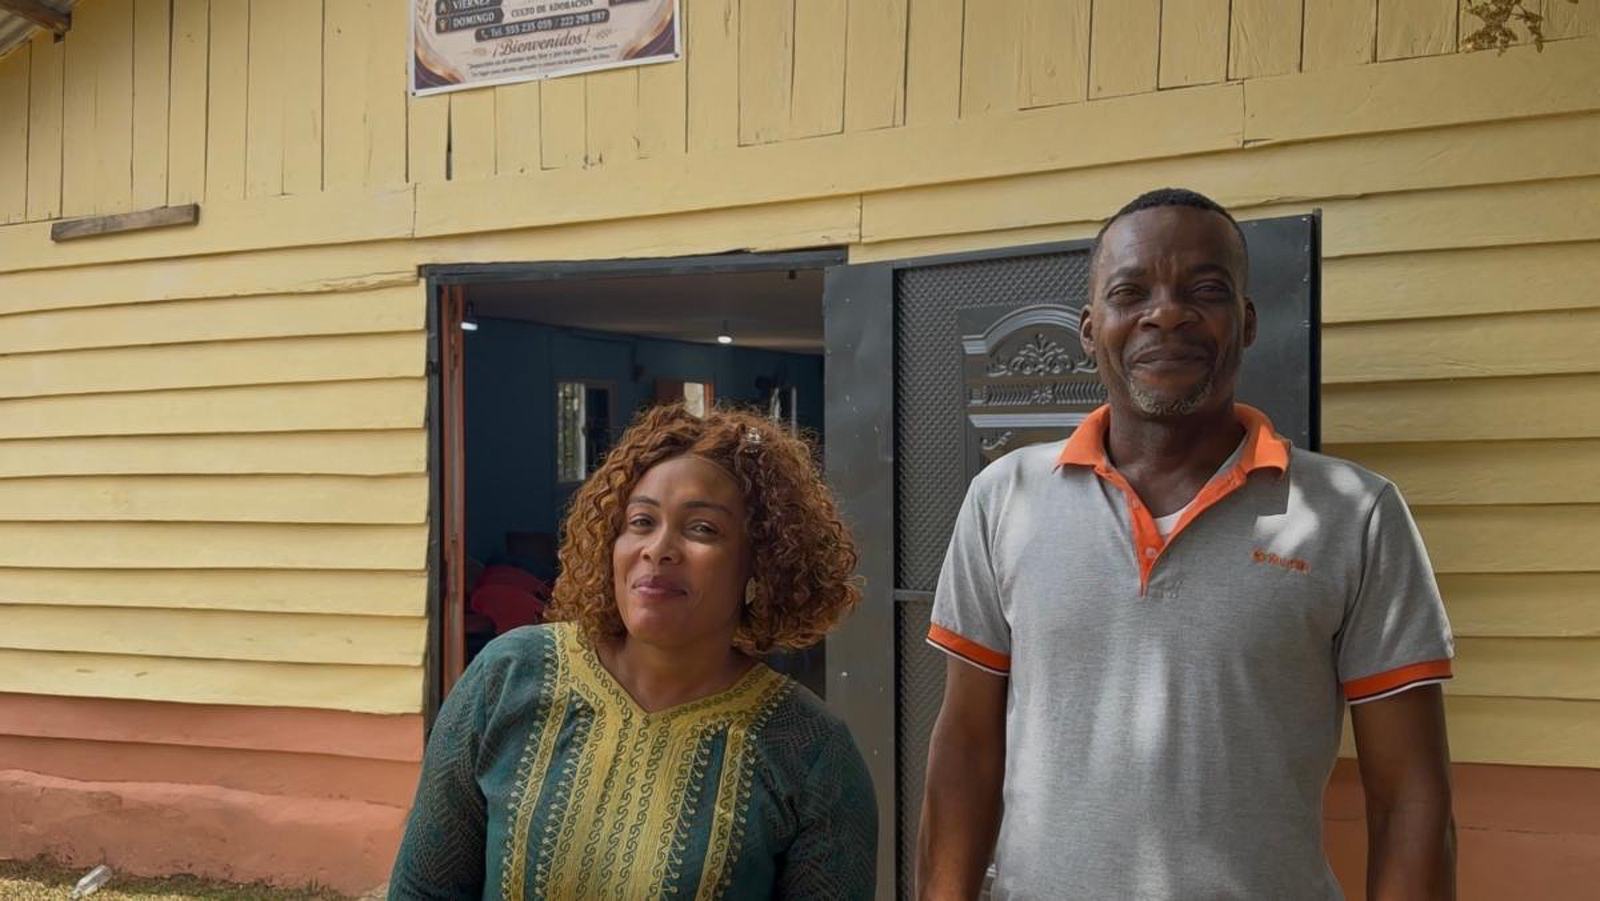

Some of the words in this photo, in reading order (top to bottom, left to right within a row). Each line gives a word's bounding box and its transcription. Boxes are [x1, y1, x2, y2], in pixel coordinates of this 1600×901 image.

[536, 5, 546, 13] DE
[453, 12, 494, 28] DOMINGO
[492, 27, 591, 58] ¡Bienvenidos!
